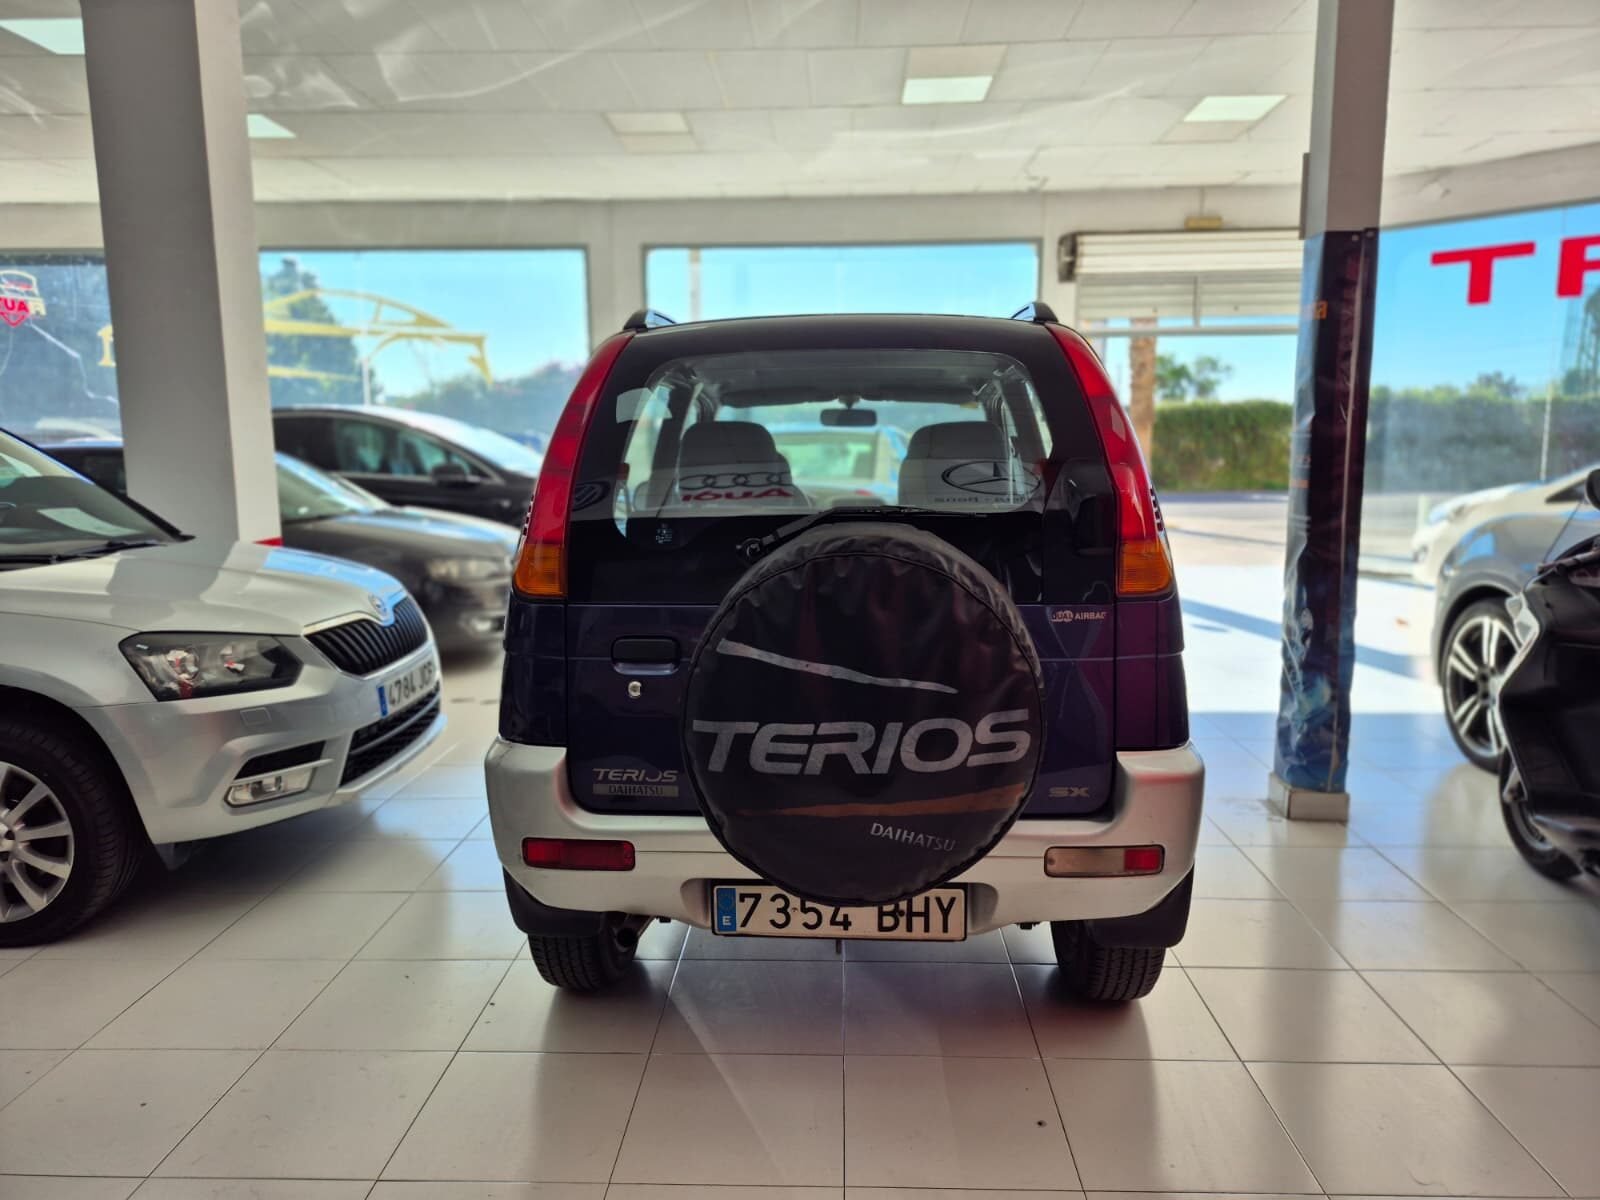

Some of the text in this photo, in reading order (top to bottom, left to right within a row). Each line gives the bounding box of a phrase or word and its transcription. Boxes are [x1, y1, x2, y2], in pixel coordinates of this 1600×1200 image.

[692, 708, 1032, 775] TERIOS
[870, 822, 957, 852] DAIHATSU
[722, 893, 957, 934] E 7354 BHY
